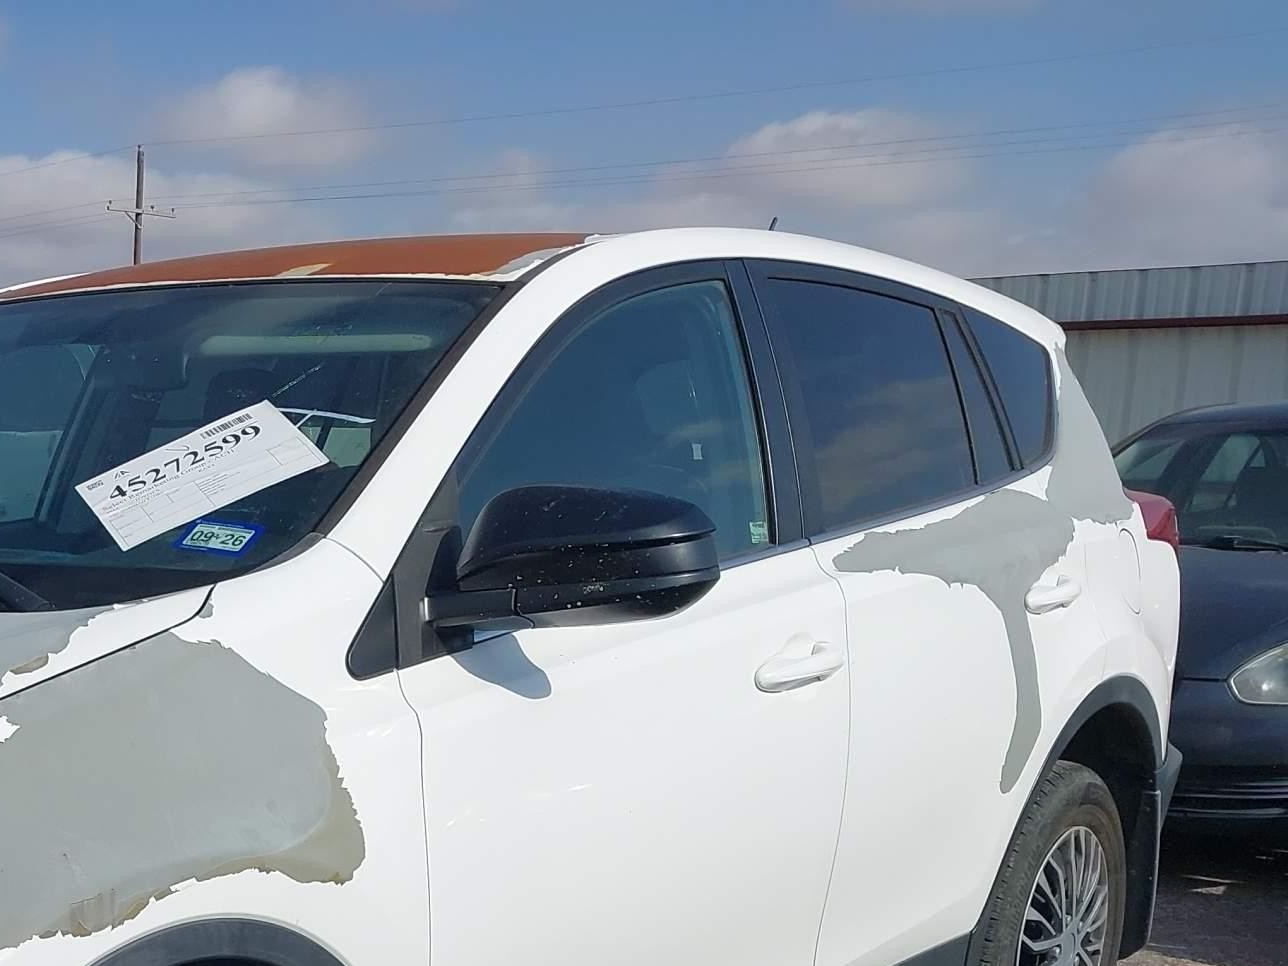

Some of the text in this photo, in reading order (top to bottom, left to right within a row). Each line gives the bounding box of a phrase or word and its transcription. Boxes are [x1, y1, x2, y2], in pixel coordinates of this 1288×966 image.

[108, 424, 261, 500] 45272599
[180, 461, 207, 476] Group
[190, 530, 247, 547] 09 26
